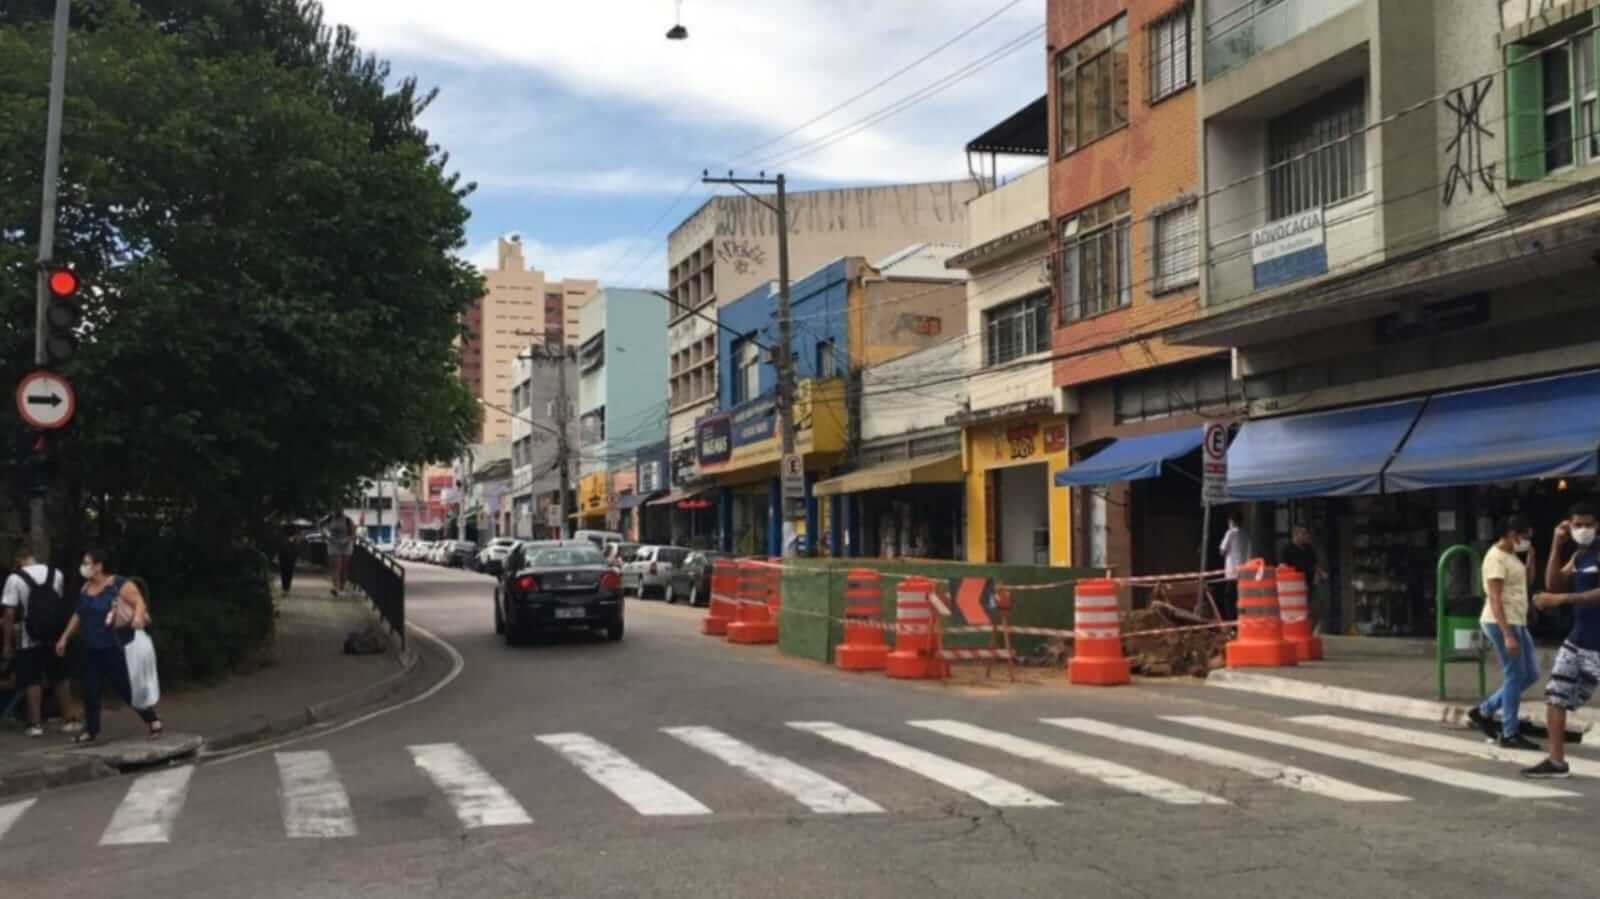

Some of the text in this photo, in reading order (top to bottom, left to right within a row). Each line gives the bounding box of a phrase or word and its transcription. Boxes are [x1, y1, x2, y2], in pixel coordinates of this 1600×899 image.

[1253, 212, 1320, 245] ADVOCACIA
[1213, 431, 1223, 452] E
[790, 459, 800, 473] E
